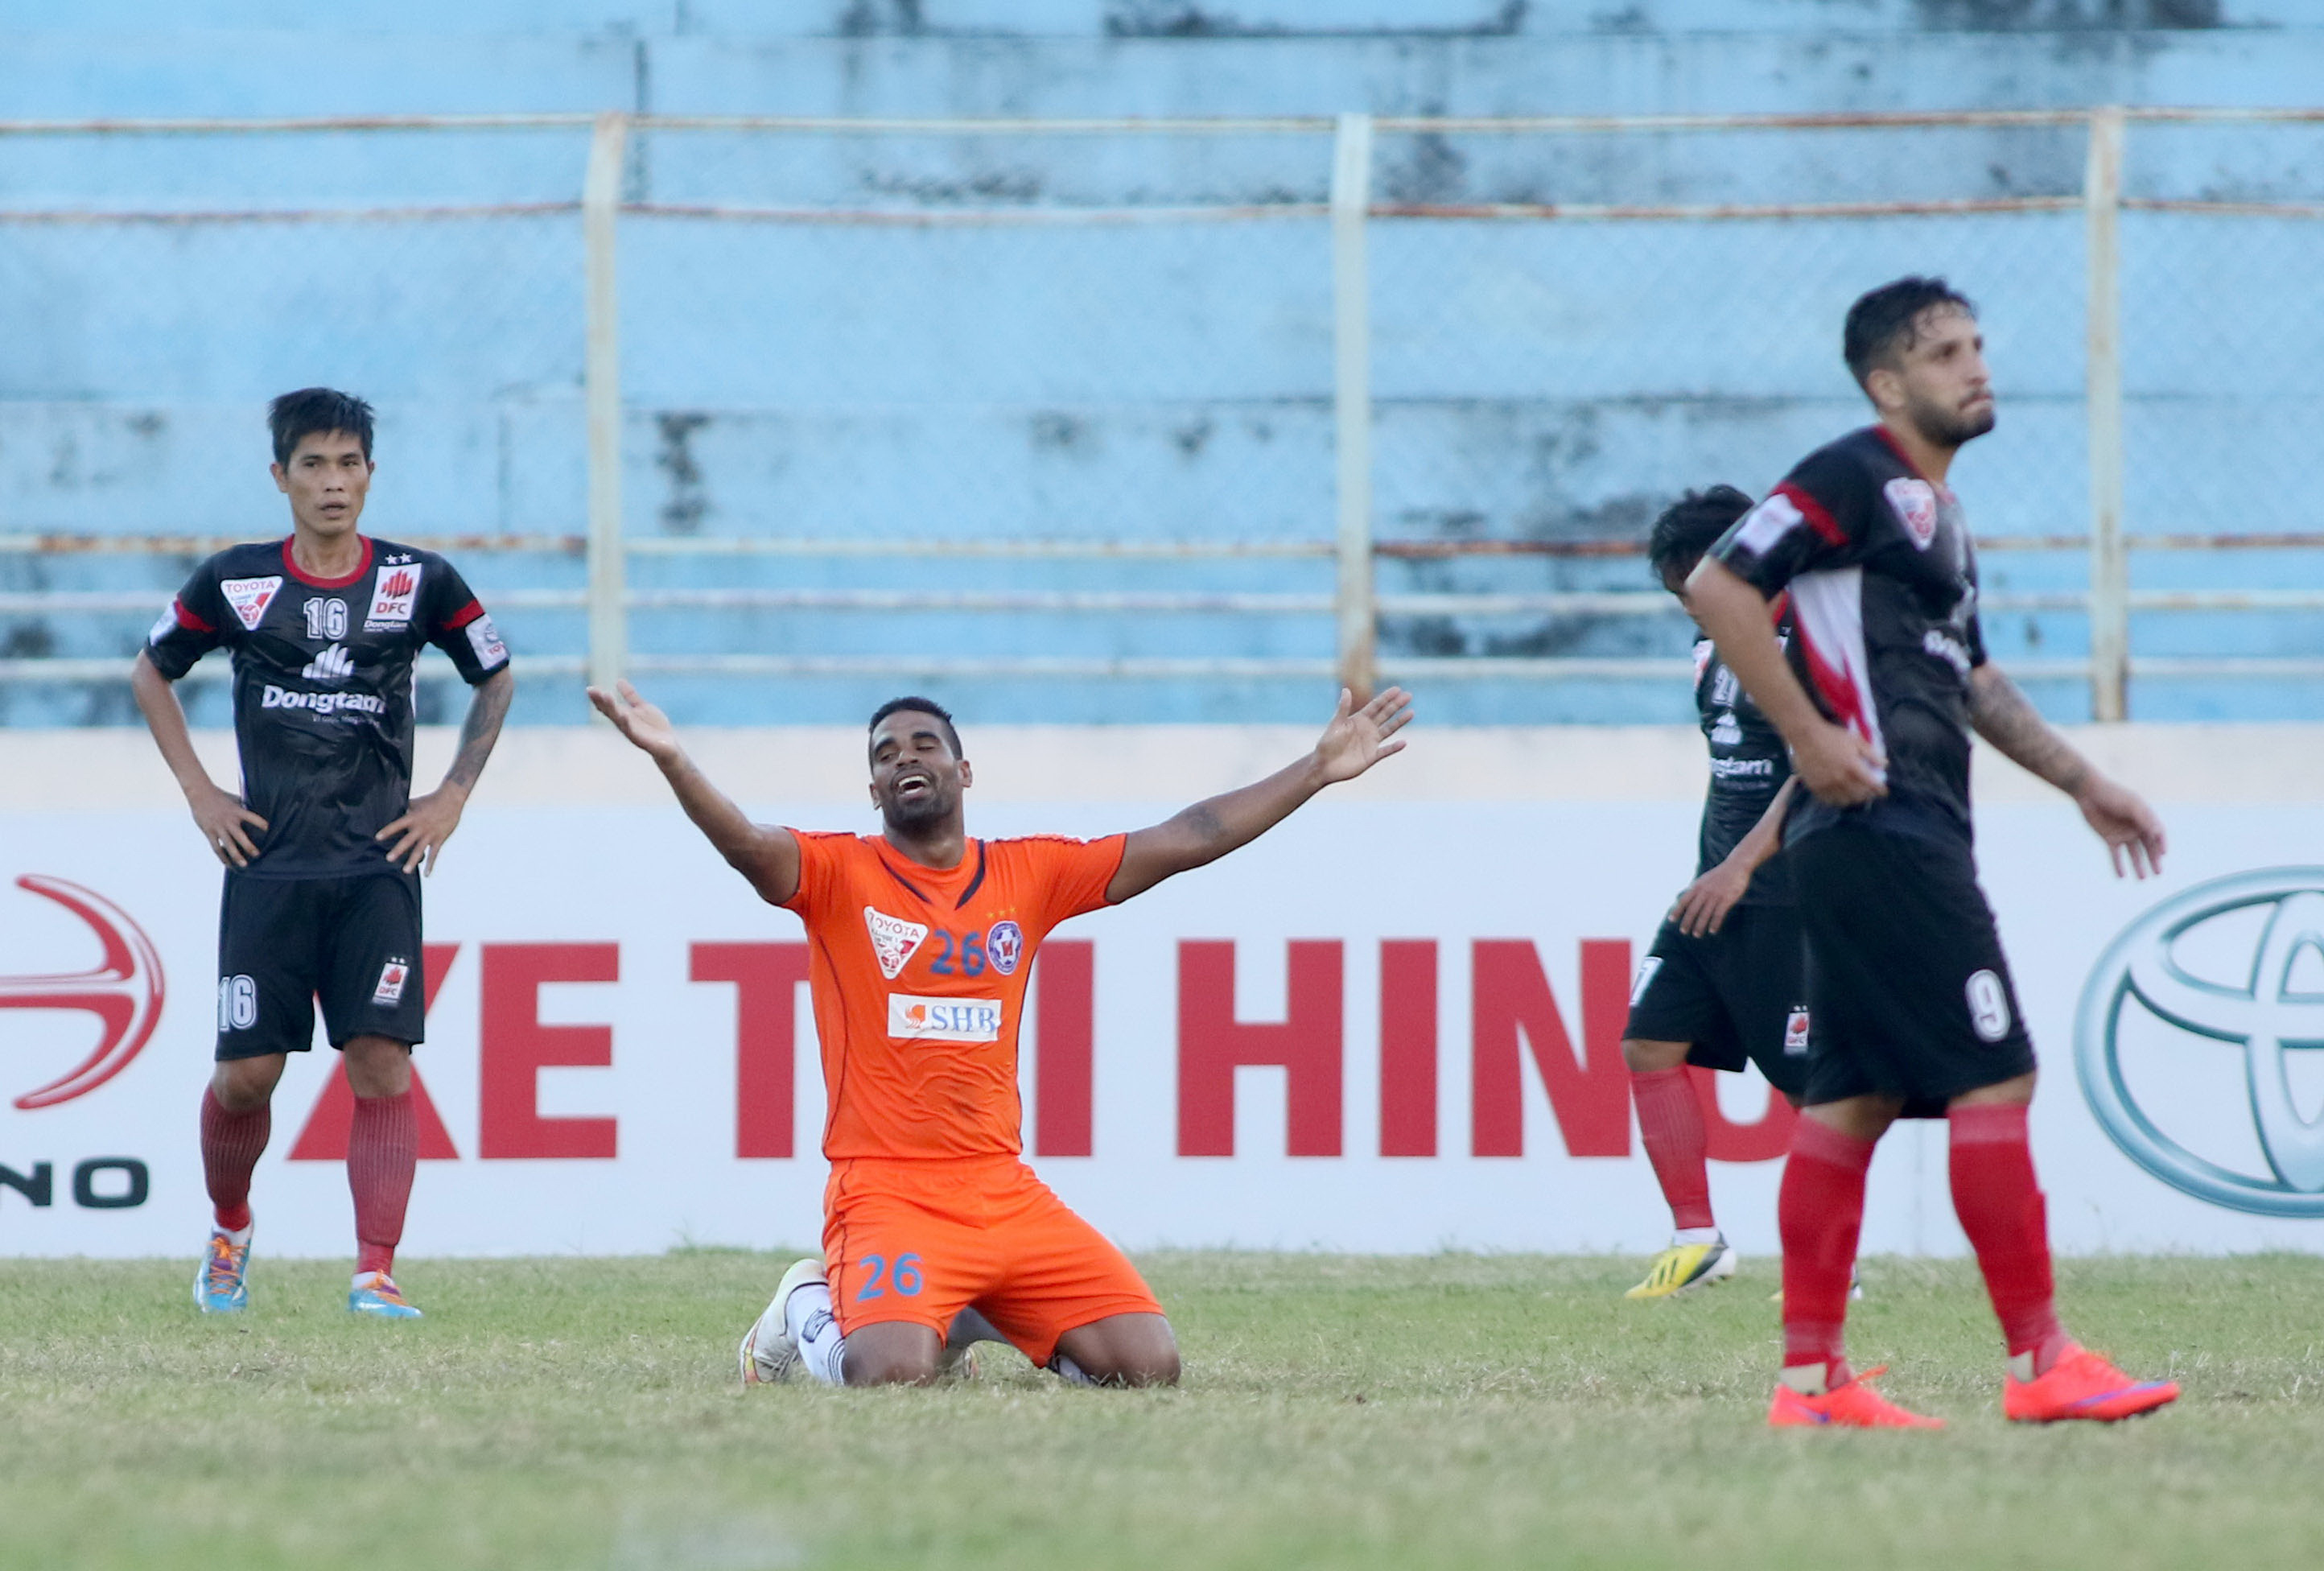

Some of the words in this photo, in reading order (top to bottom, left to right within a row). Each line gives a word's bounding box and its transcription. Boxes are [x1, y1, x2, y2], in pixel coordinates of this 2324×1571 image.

[225, 580, 275, 593] TOYOTA
[375, 601, 407, 615] DFC
[303, 597, 348, 639] 16
[262, 684, 386, 714] Dongtam
[929, 929, 986, 977] 26
[219, 974, 257, 1031] 16
[931, 1004, 995, 1033] SHB
[1965, 969, 2011, 1042] 9
[689, 940, 1094, 1159] TI
[856, 1252, 923, 1302] 26
